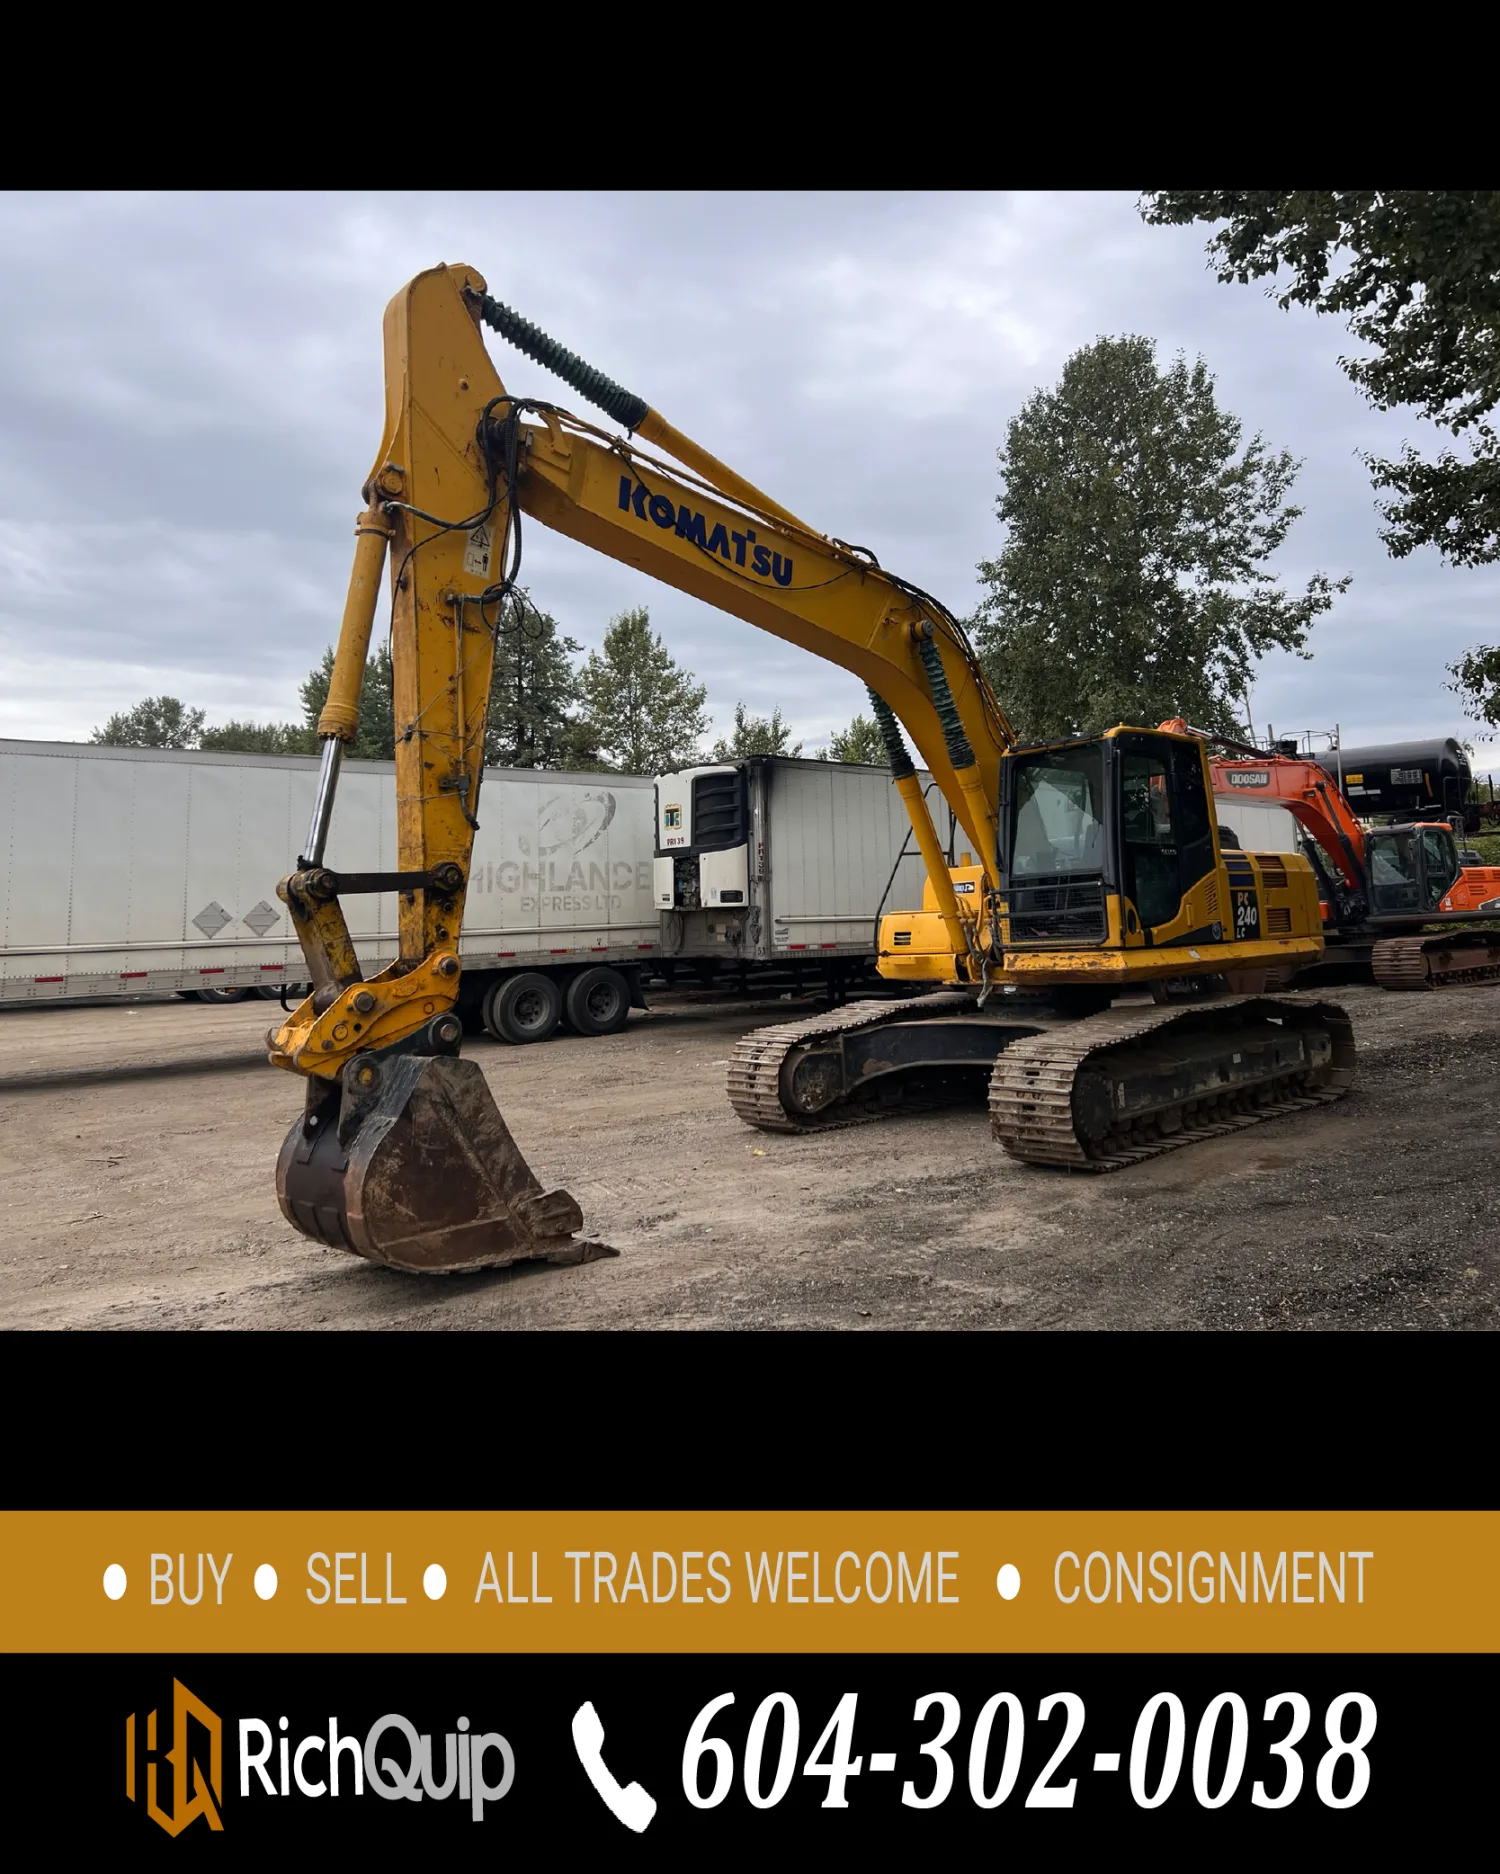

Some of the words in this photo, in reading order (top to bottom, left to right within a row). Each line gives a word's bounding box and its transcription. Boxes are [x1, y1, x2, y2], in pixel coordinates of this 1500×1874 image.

[618, 475, 793, 587] KOMATSU
[1231, 773, 1268, 784] DOOSAN
[471, 861, 652, 894] HIGHLANDE
[520, 896, 590, 912] EXPRESS
[1237, 892, 1249, 906] PC
[1237, 906, 1257, 926] 240
[1236, 927, 1246, 939] LC
